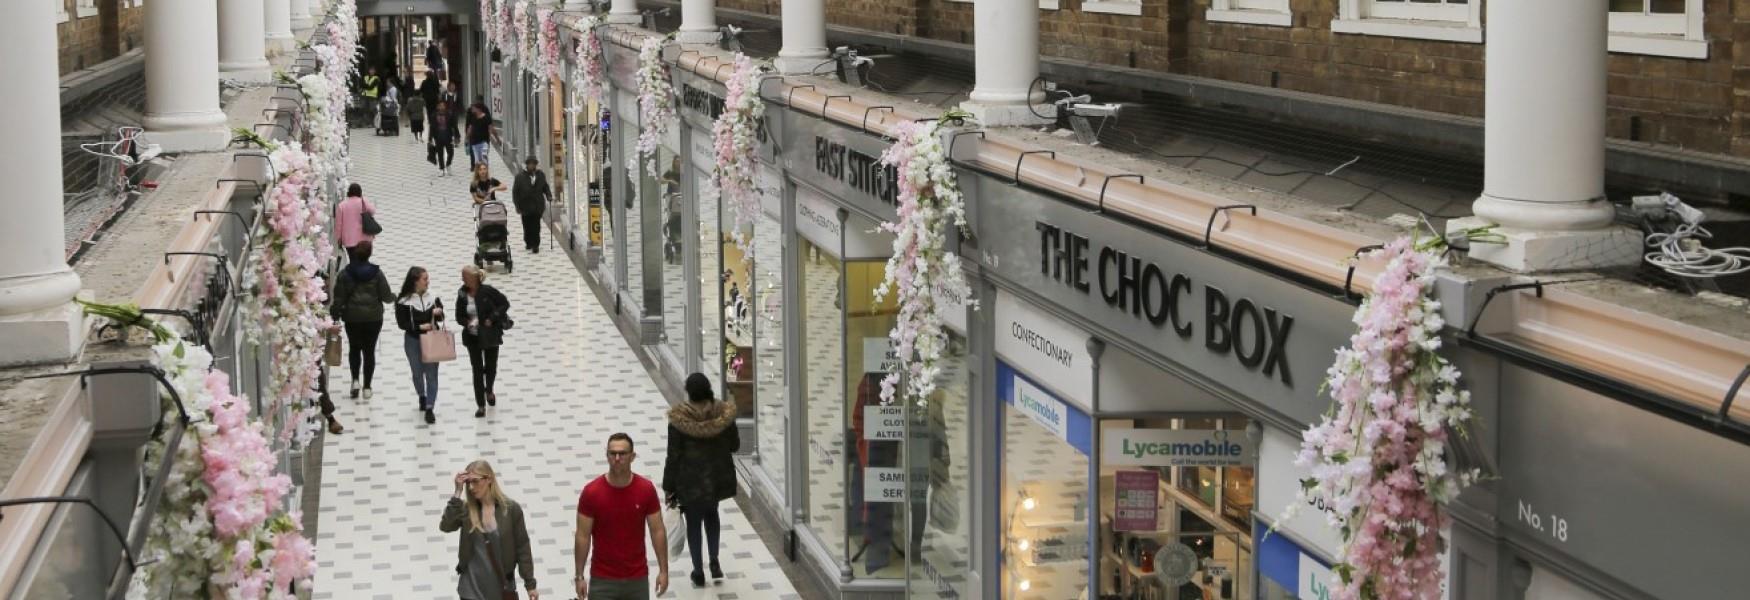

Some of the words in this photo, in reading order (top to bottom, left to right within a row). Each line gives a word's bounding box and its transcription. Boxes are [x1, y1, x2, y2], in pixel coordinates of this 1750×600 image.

[815, 135, 846, 182] FAST
[1035, 221, 1091, 294] THE
[1097, 245, 1192, 338] CHOC
[1205, 285, 1295, 388] BOX
[1011, 321, 1073, 368] CONFECTIONARY
[1019, 387, 1060, 426] Lycamobile
[1122, 437, 1242, 459] Lycamobile
[1518, 498, 1544, 532] No.
[1551, 514, 1568, 541] 18
